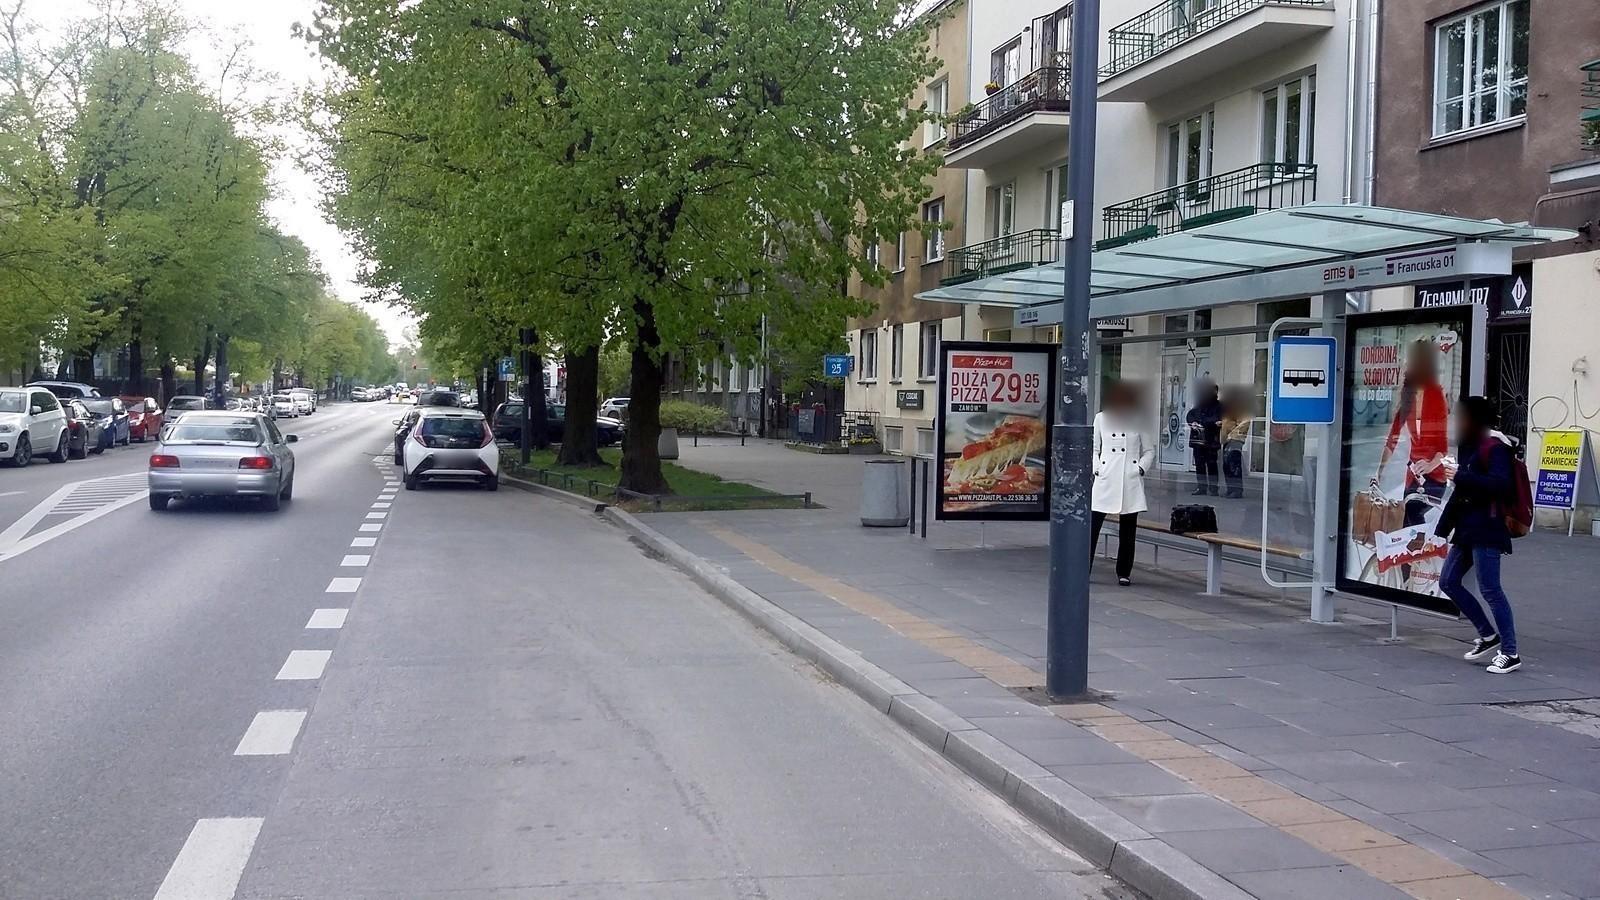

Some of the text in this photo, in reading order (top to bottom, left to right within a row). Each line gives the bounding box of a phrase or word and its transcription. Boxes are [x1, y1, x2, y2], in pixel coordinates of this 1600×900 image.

[1397, 257, 1441, 274] Francuska
[1443, 255, 1454, 268] 01
[1323, 266, 1346, 281] ams
[1419, 287, 1490, 308] ZEGARMITRZ
[972, 357, 1009, 366] Pizza Hut
[1360, 346, 1397, 364] ODROBINA
[831, 364, 842, 374] 25
[951, 370, 989, 387] DUŻA
[1363, 368, 1400, 385] SŁODYCZY
[990, 373, 1040, 402] 29 95
[951, 388, 988, 402] PIZZA
[1024, 390, 1040, 403] ZŁ
[1367, 391, 1375, 400] co
[1545, 446, 1580, 455] POPRAWKI
[1541, 457, 1578, 466] KRAWIECKIE
